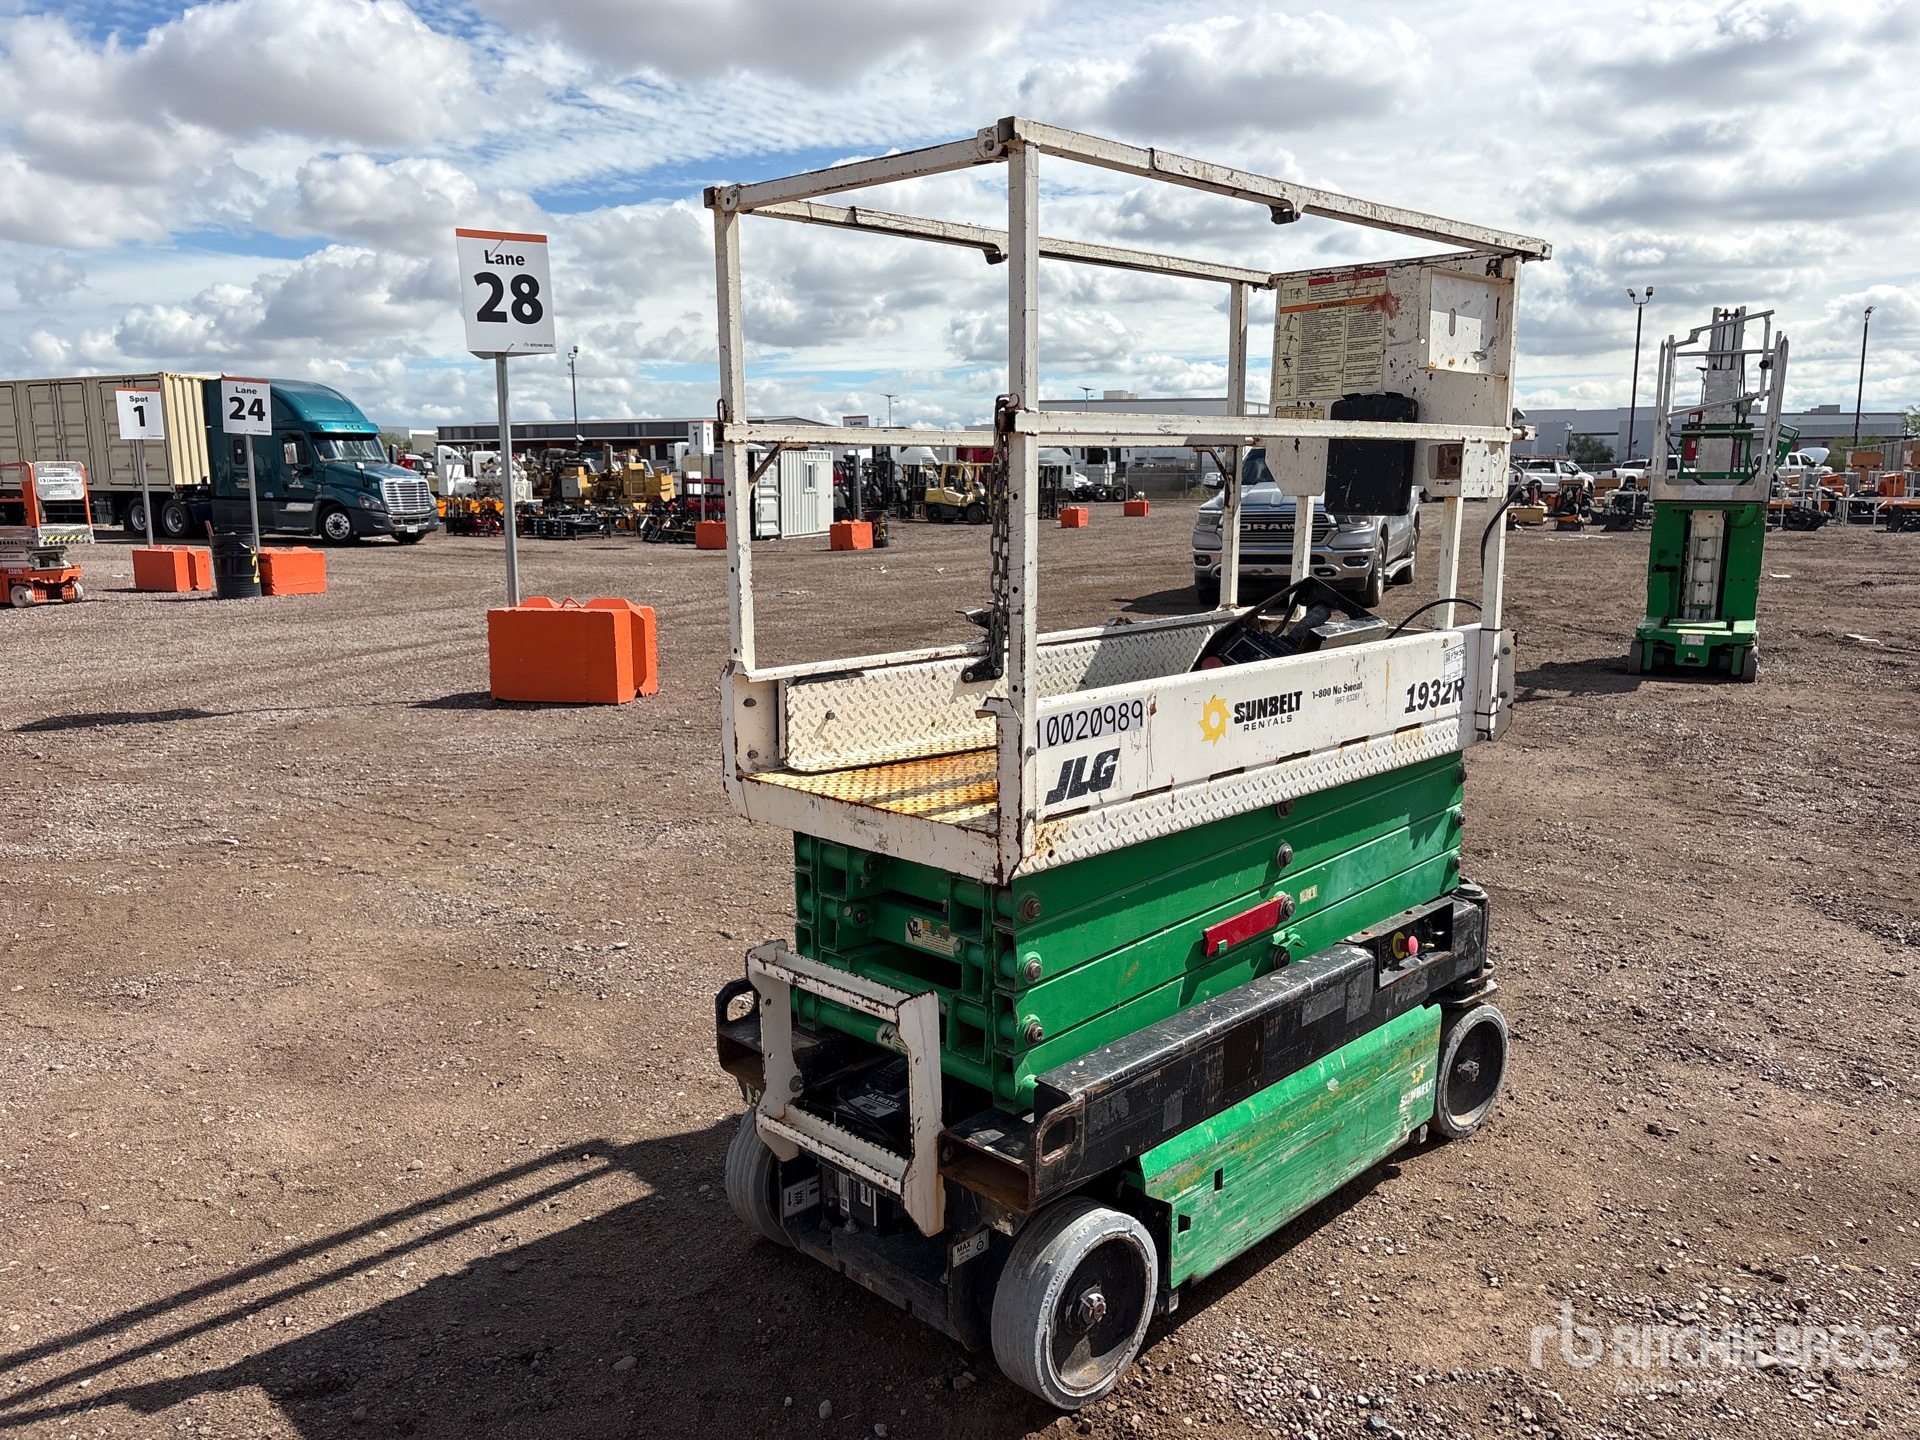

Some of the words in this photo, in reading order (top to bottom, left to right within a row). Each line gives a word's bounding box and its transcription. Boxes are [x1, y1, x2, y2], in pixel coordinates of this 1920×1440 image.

[484, 249, 526, 266] Lane
[473, 271, 544, 325] 28
[1323, 300, 1346, 309] WARNING
[129, 395, 149, 403] Spot
[235, 386, 257, 395] Lane
[133, 405, 146, 427] 1
[229, 396, 266, 422] 24
[693, 431, 698, 446] 1
[706, 432, 710, 446] 1
[874, 523, 887, 541] 25
[1233, 690, 1303, 725] SUNBELT
[1311, 688, 1332, 700] 1-800
[1332, 685, 1342, 696] No
[1343, 681, 1363, 694] Sweat
[1404, 677, 1465, 714] 1932R
[1243, 714, 1293, 733] RENTALS
[1044, 747, 1121, 806] JLG
[866, 1093, 900, 1108] ALWAYS
[956, 1240, 971, 1254] MAX
